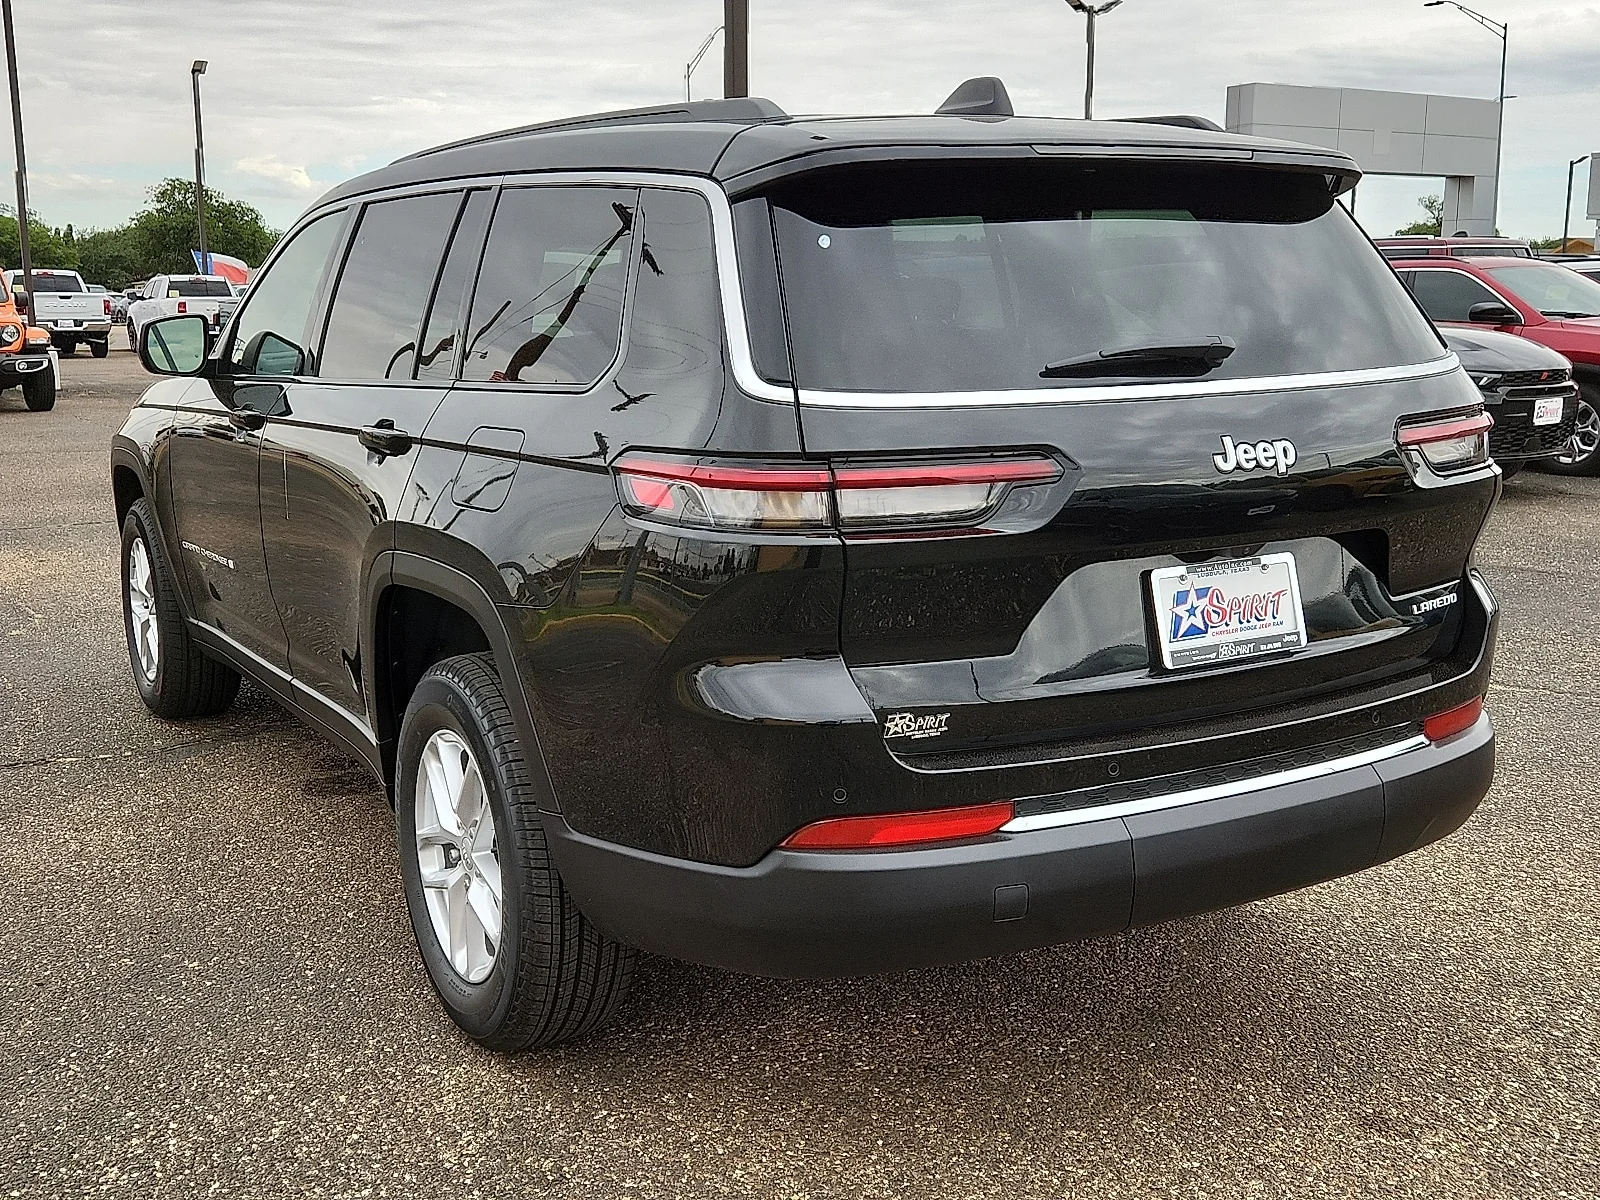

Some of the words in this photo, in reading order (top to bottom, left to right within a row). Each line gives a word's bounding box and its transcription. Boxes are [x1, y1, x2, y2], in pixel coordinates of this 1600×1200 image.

[1212, 435, 1297, 476] Jeep
[1206, 588, 1288, 627] SPIRIT
[1412, 593, 1458, 615] LAREDO
[1211, 627, 1239, 637] CHRYSLER
[1239, 624, 1258, 633] DODGE
[1258, 622, 1272, 630] JEEP
[1228, 642, 1256, 658] SPIRIT
[903, 713, 951, 731] SPIRIT
